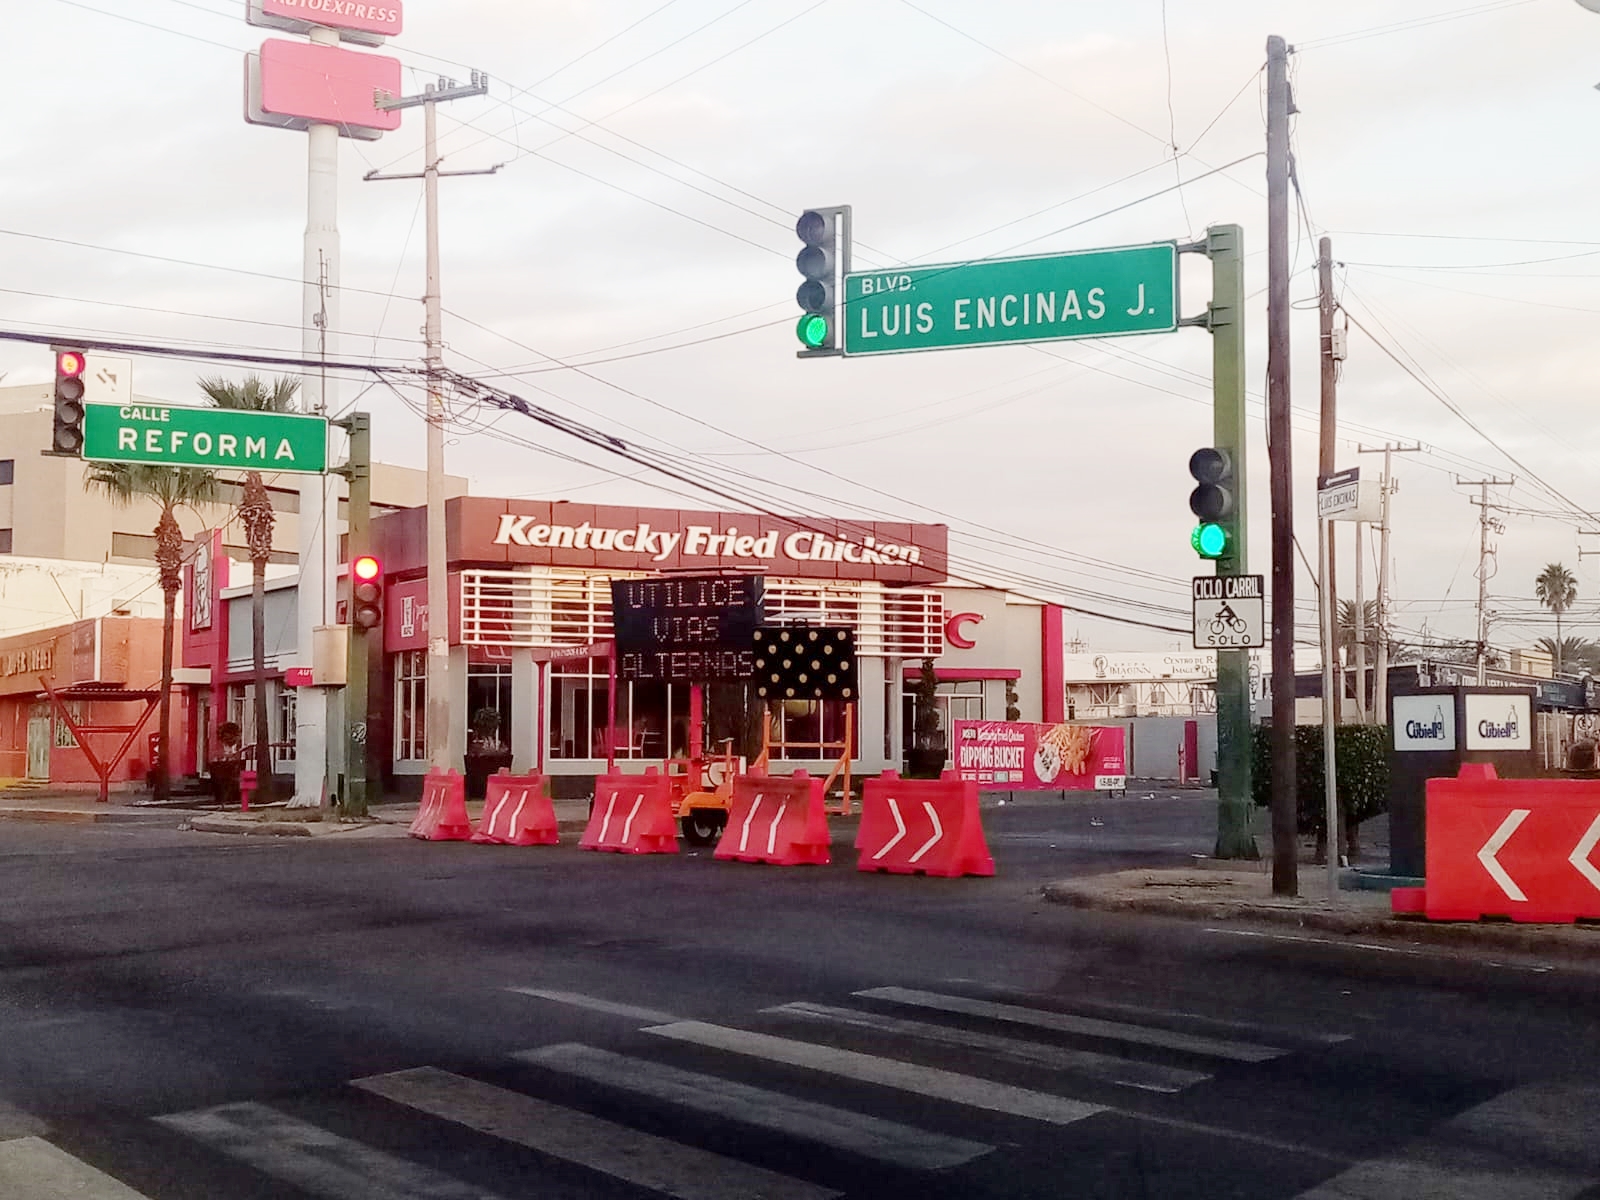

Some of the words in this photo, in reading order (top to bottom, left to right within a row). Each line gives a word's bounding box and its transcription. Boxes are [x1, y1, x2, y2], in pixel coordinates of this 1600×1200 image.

[861, 275, 916, 294] BLVD.
[861, 302, 934, 338] LUIS
[954, 287, 1105, 331] ENCINAS
[1127, 283, 1154, 316] J.
[119, 407, 170, 422] CALLE
[118, 427, 296, 461] REFORMA
[494, 514, 681, 561] Kentucky
[683, 526, 780, 559] Fried
[628, 579, 745, 608] UTILICE
[1194, 579, 1223, 599] CICLO
[1226, 577, 1262, 597] CARRIL
[654, 616, 720, 643] VIAS
[1208, 634, 1251, 645] SOLO
[623, 651, 754, 678] ALTERNAS
[960, 746, 993, 768] DIPPING
[994, 746, 1024, 768] BUCKET
